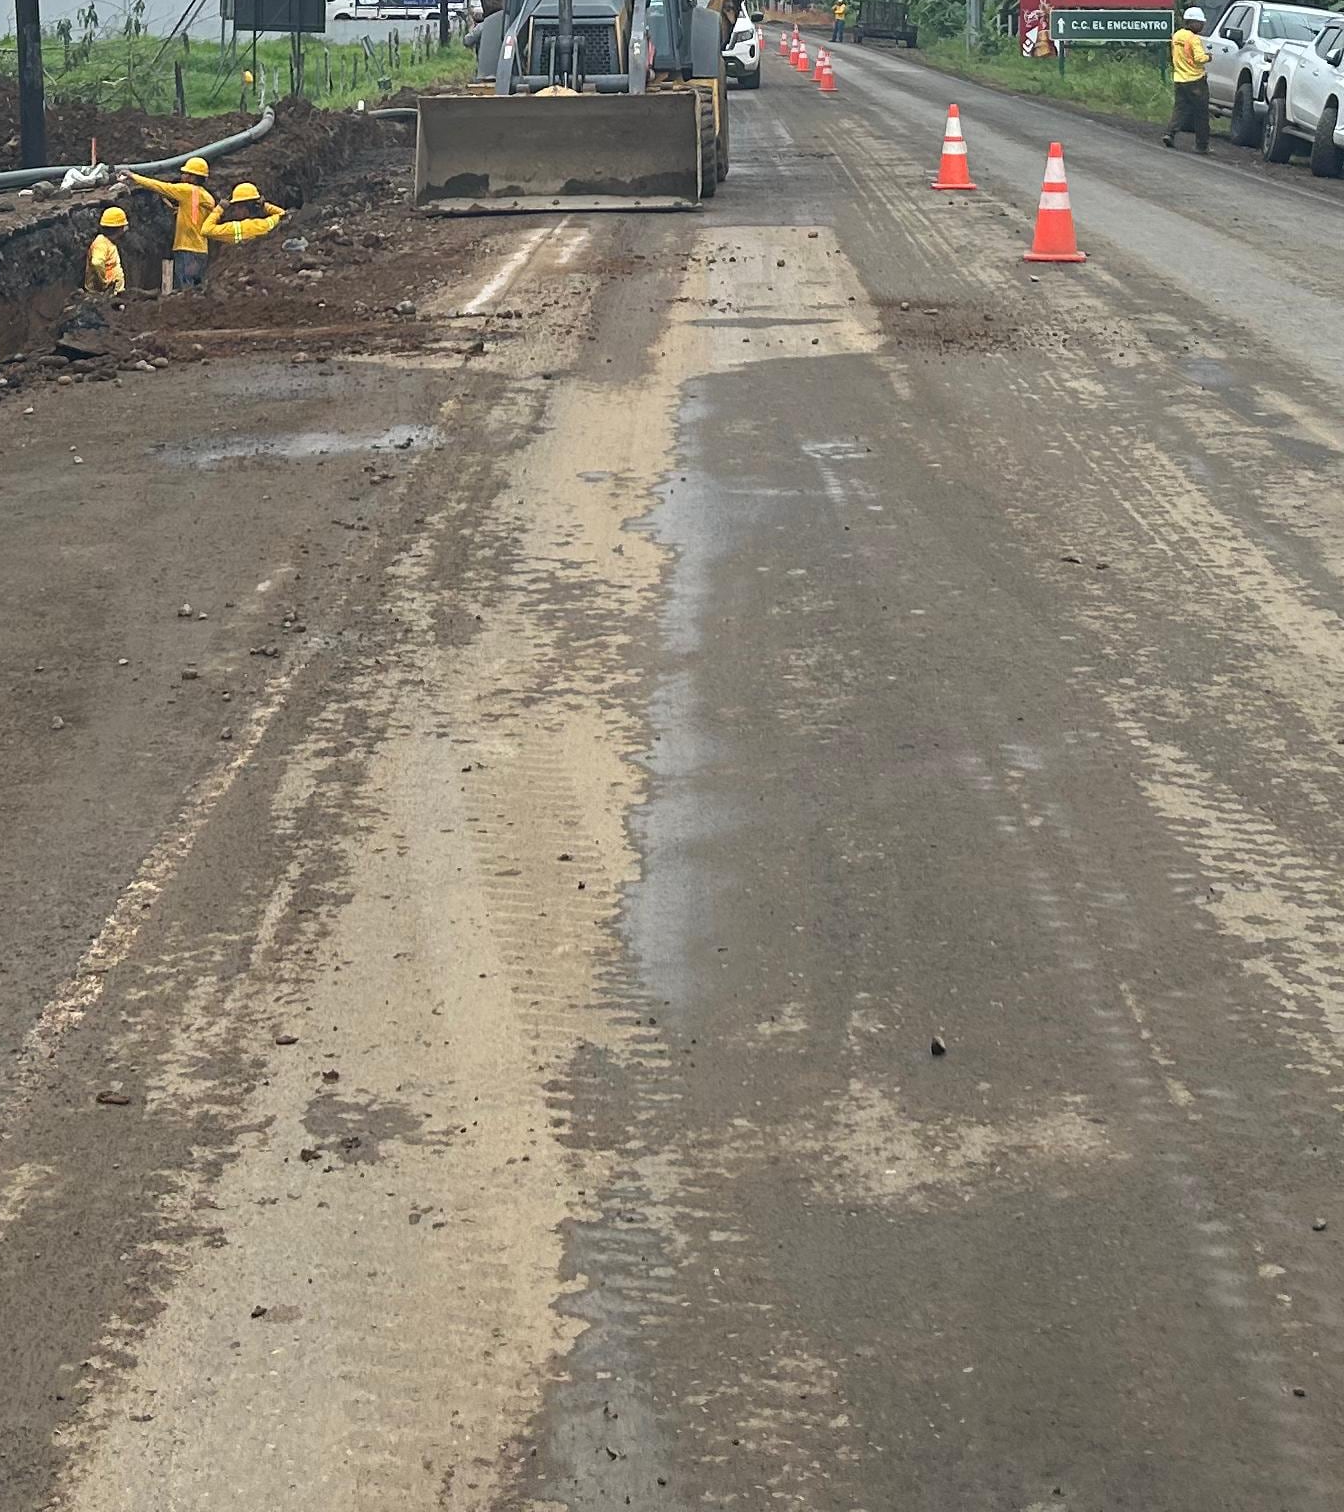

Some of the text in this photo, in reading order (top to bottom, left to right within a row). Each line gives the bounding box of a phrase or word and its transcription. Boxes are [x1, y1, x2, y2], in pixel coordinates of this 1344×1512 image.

[1071, 21, 1168, 30] C.C. EL ENCUENTRO
